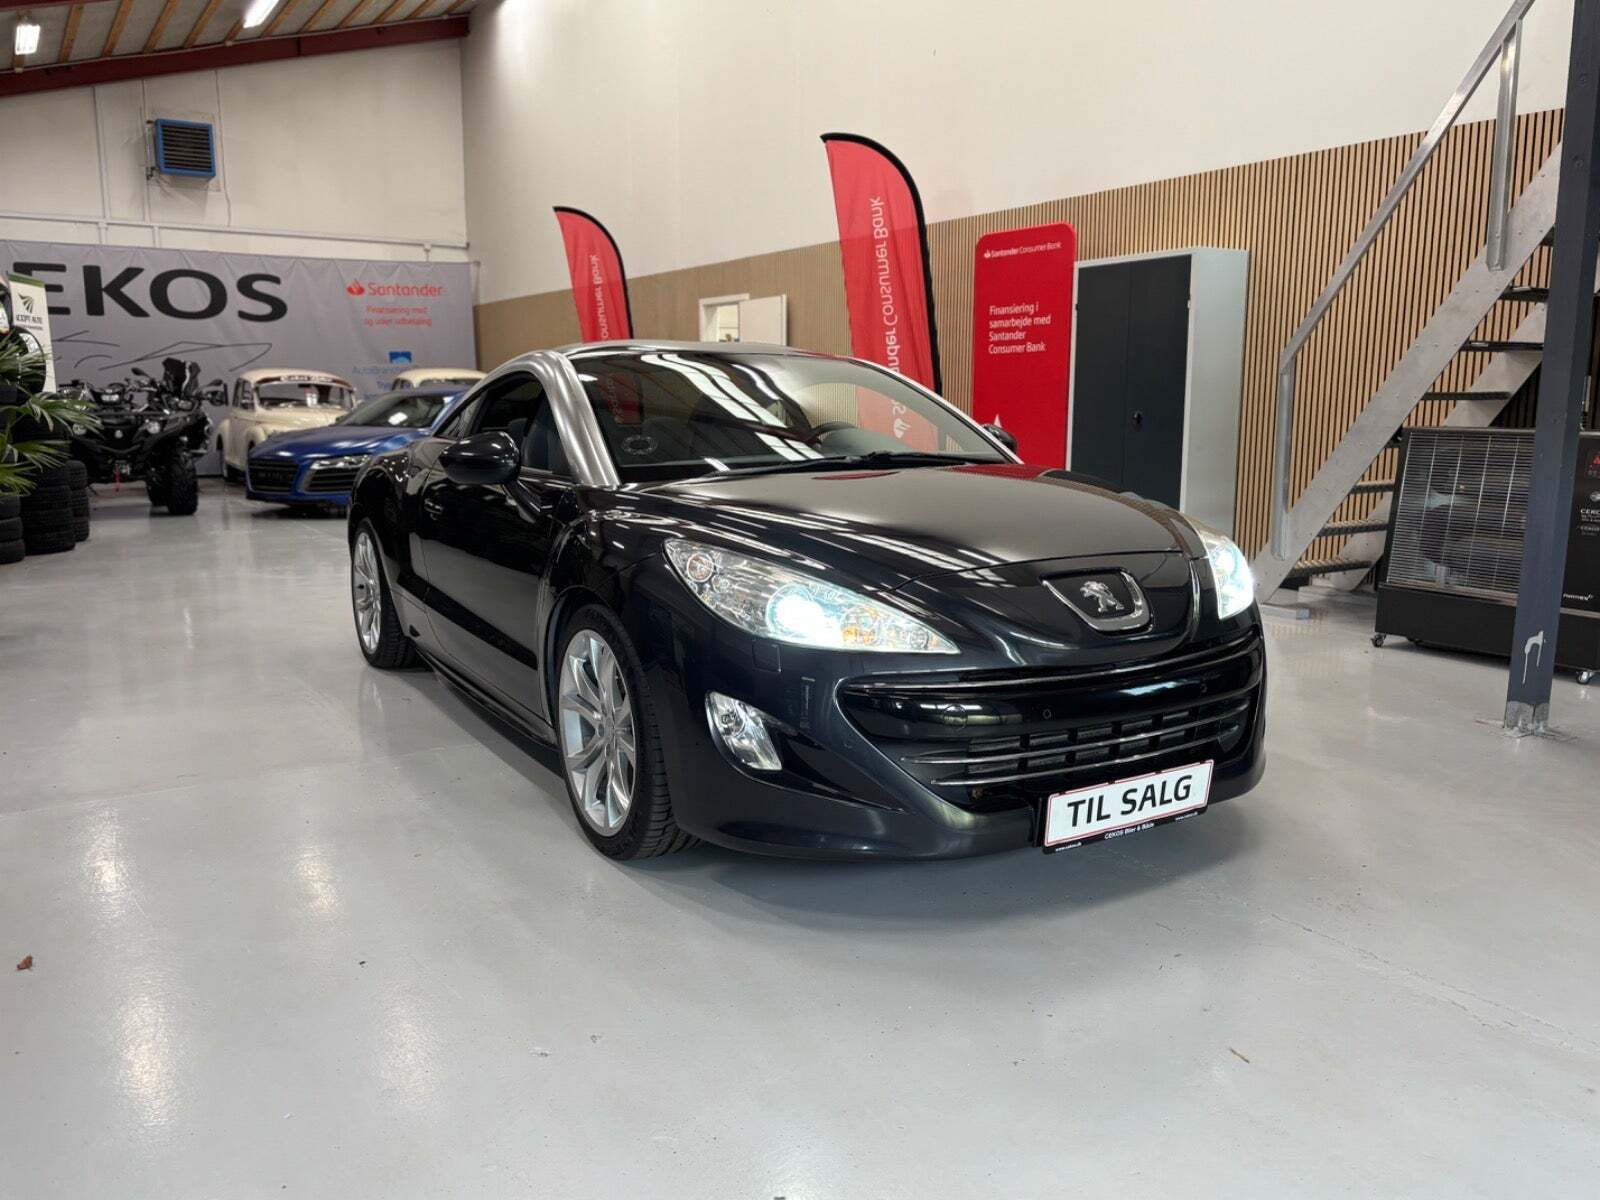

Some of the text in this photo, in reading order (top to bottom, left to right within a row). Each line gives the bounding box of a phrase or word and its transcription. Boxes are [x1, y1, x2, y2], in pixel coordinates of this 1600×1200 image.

[991, 242, 1062, 258] Santander Consumer Bank
[13, 261, 288, 322] EKOS
[367, 282, 443, 297] Santander
[989, 303, 1035, 316] Finansiering
[989, 314, 1052, 329] samarbejde med
[989, 330, 1026, 341] Santander
[988, 341, 1046, 354] Consumer Bank
[1067, 774, 1192, 827] TIL SALG
